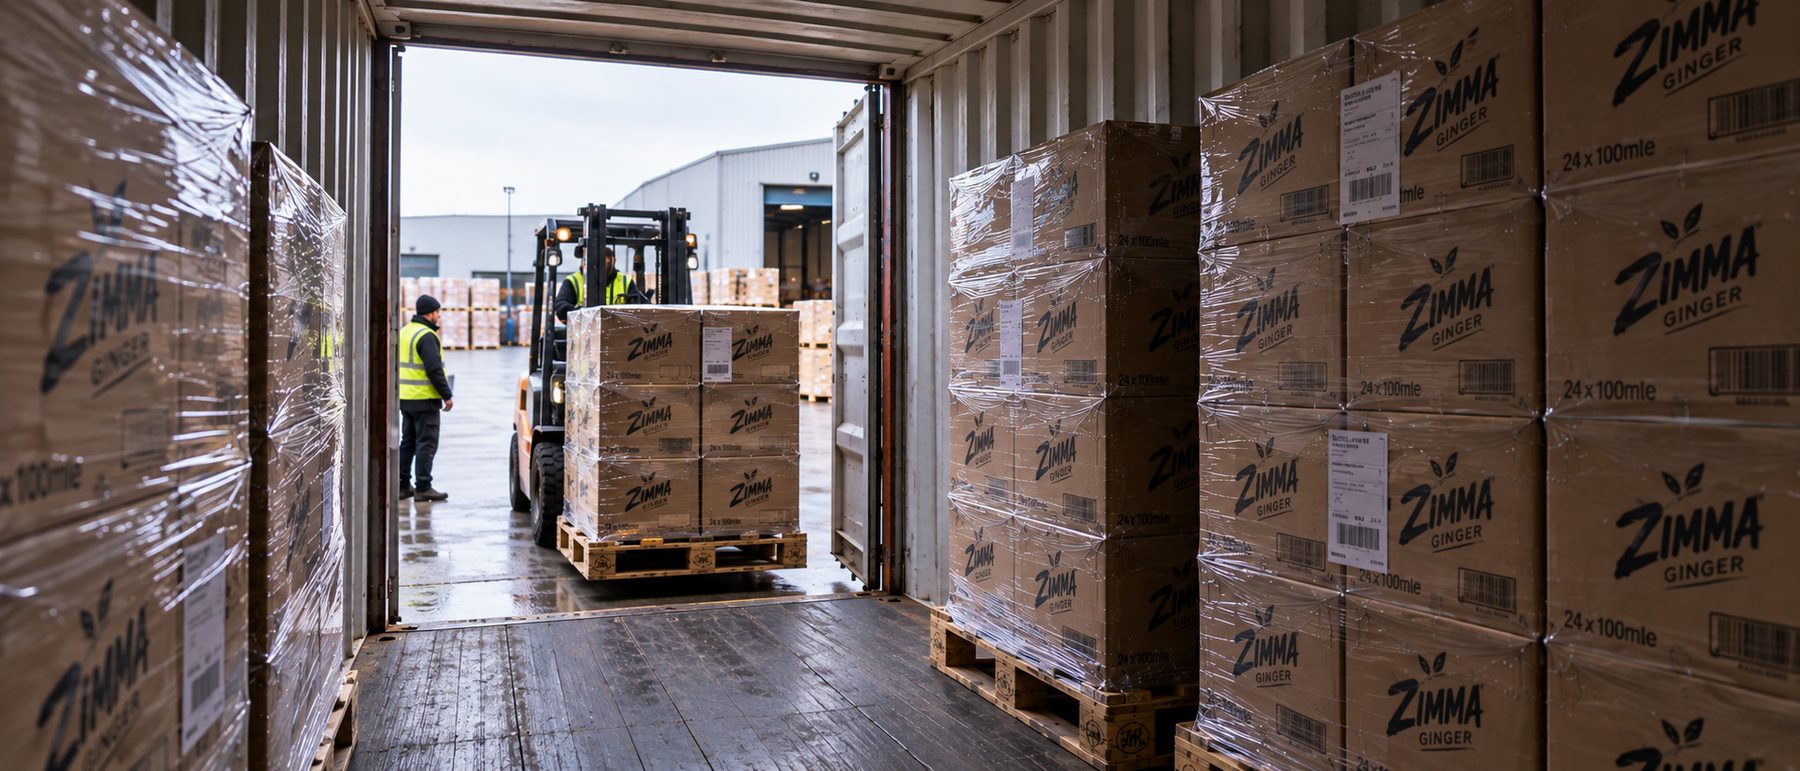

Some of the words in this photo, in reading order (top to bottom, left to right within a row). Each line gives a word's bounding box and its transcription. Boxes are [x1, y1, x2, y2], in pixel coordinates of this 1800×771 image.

[1663, 37, 1742, 90] GINGER
[1403, 57, 1499, 157] ZIMMA
[1436, 106, 1488, 147] GINGER
[1238, 114, 1304, 195] ZIMMA
[1260, 155, 1296, 187] GINGER
[1563, 151, 1581, 171] 24
[1614, 224, 1760, 336] ZIMMA
[41, 249, 159, 393] ZIMMA
[1236, 284, 1300, 353] ZIMMA
[1399, 266, 1495, 352] ZIMMA
[1663, 286, 1743, 327] GINGER
[1037, 300, 1077, 353] ZIMMA
[1258, 324, 1293, 349] GINGER
[1432, 313, 1482, 346] GINGER
[627, 332, 672, 362] ZIMMA
[732, 333, 773, 361] ZIMMA
[1360, 381, 1373, 396] 24
[1564, 379, 1582, 399] 24
[626, 405, 672, 436] ZIMMA
[730, 404, 773, 434] ZIMMA
[965, 426, 994, 465] ZIMMA
[1036, 435, 1076, 480] ZIMMA
[624, 480, 672, 512] ZIMMA
[729, 477, 773, 508] ZIMMA
[1234, 458, 1299, 516] ZIMMA
[1257, 497, 1291, 516] GINGER
[1399, 478, 1495, 546] ZIMMA
[1431, 524, 1482, 548] GINGER
[1614, 495, 1764, 580] ZIMMA
[965, 542, 994, 577] ZIMMA
[1359, 568, 1372, 584] 24
[1664, 556, 1745, 583] GINGER
[1035, 568, 1077, 608] ZIMMA
[1564, 609, 1583, 630] 24
[1232, 628, 1299, 678] ZIMMA
[1256, 670, 1291, 683] GINGER
[1386, 677, 1484, 737] ZIMMA
[1419, 731, 1472, 746] GINGER
